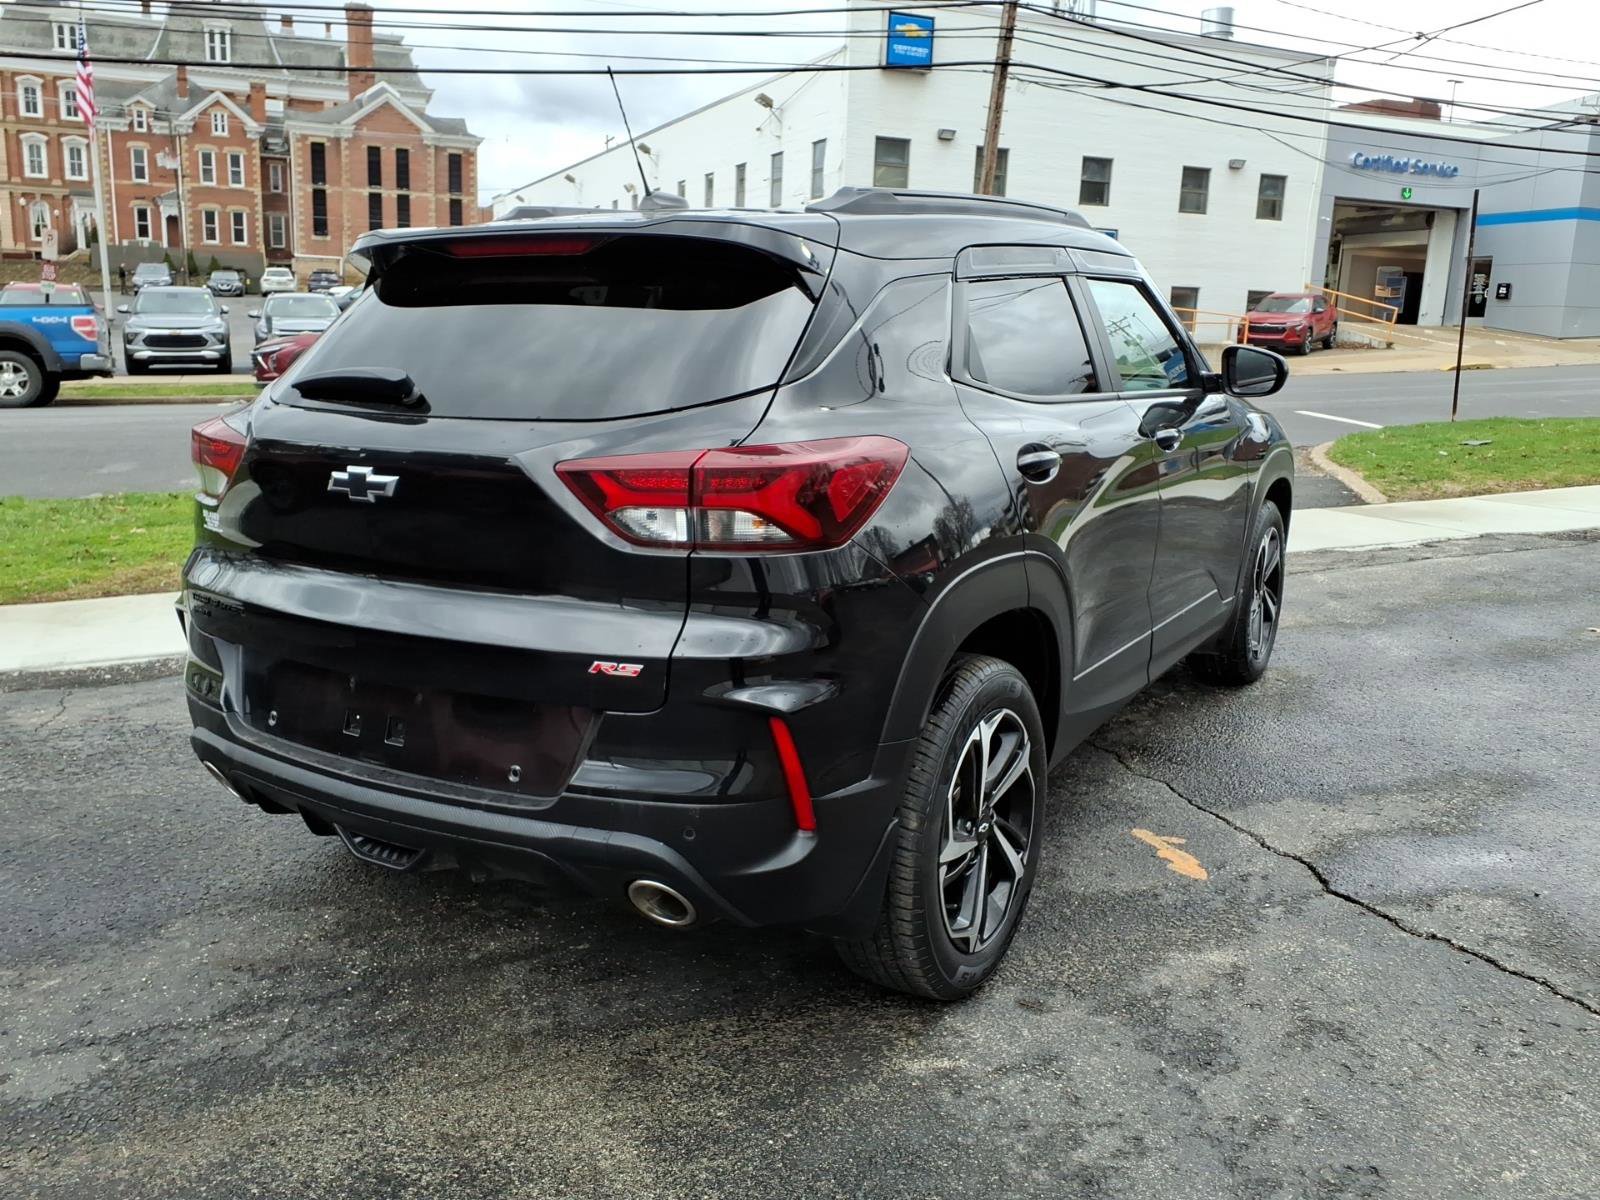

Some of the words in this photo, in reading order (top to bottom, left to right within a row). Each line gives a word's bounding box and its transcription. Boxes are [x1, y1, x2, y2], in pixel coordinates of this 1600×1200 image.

[1353, 152, 1410, 174] Certified
[1413, 159, 1459, 178] Service
[588, 661, 644, 677] RS
